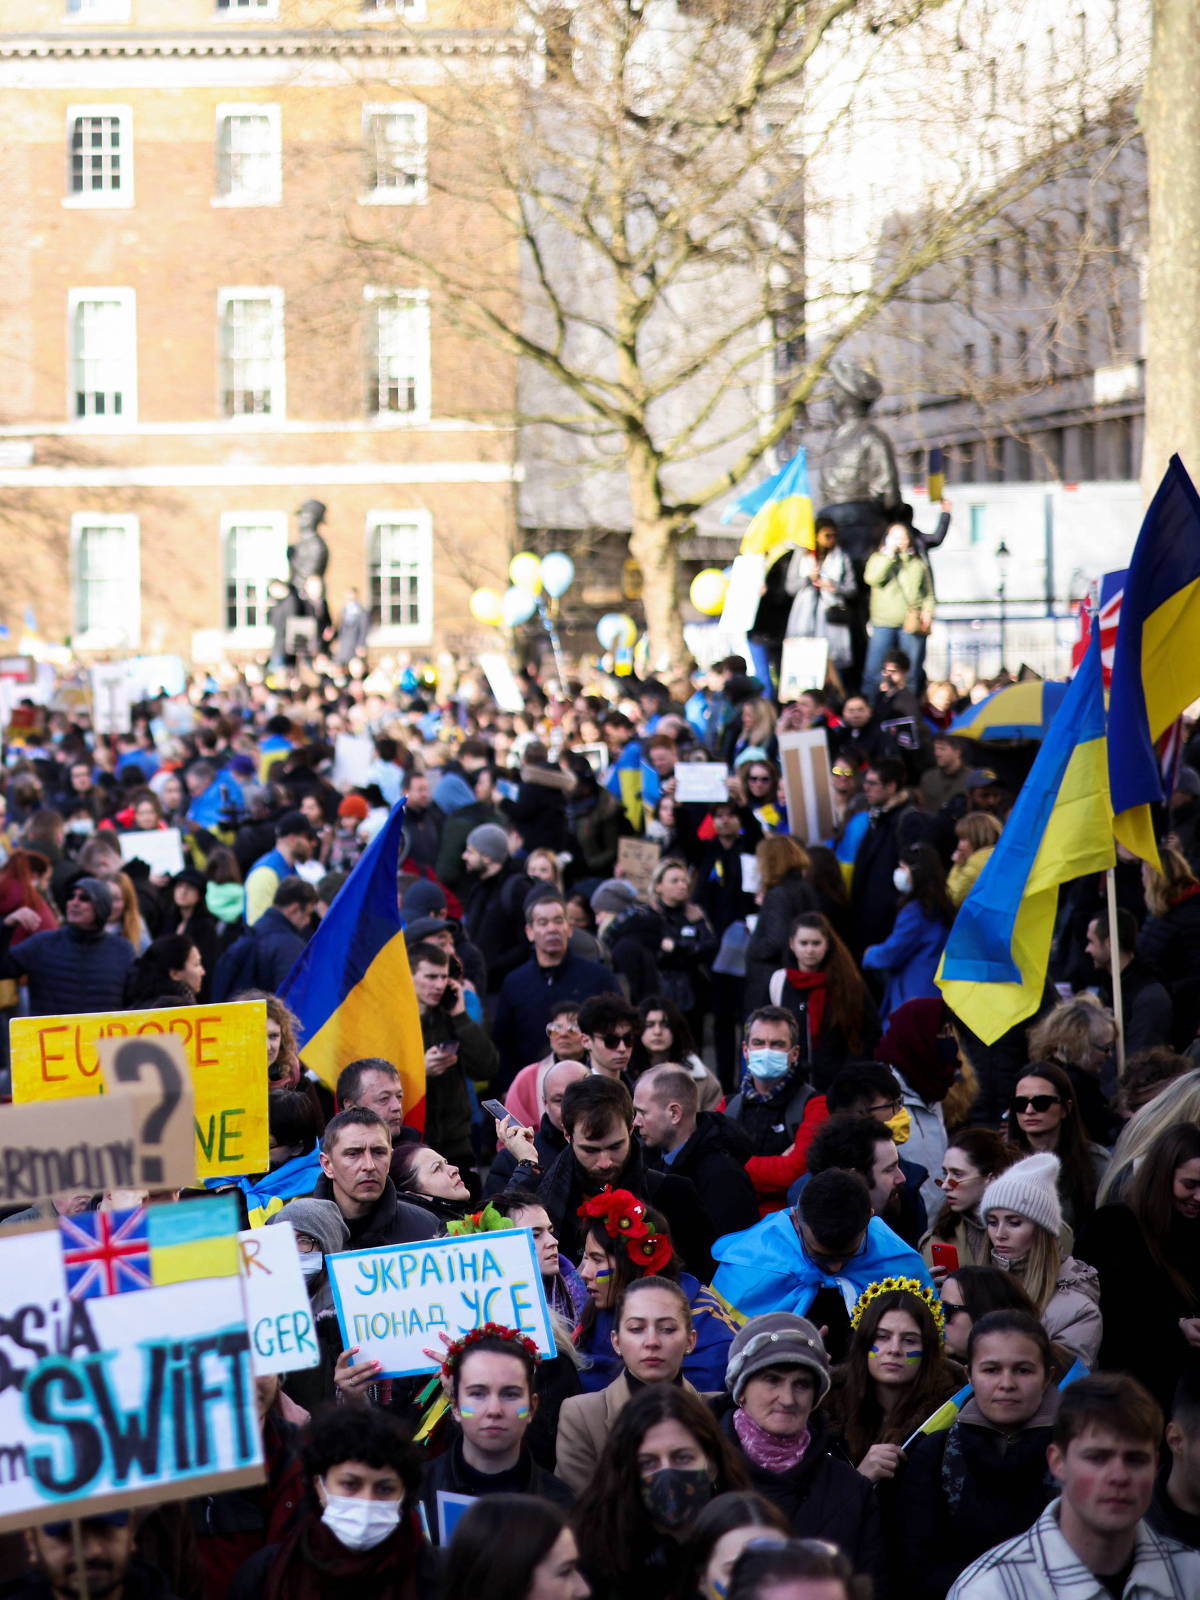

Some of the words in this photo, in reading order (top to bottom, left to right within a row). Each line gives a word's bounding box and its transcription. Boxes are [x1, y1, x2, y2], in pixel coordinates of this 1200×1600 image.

[354, 1247, 505, 1296] УКРАЇНА
[354, 1304, 448, 1342] ПОНАД
[457, 1282, 537, 1335] УСЕ
